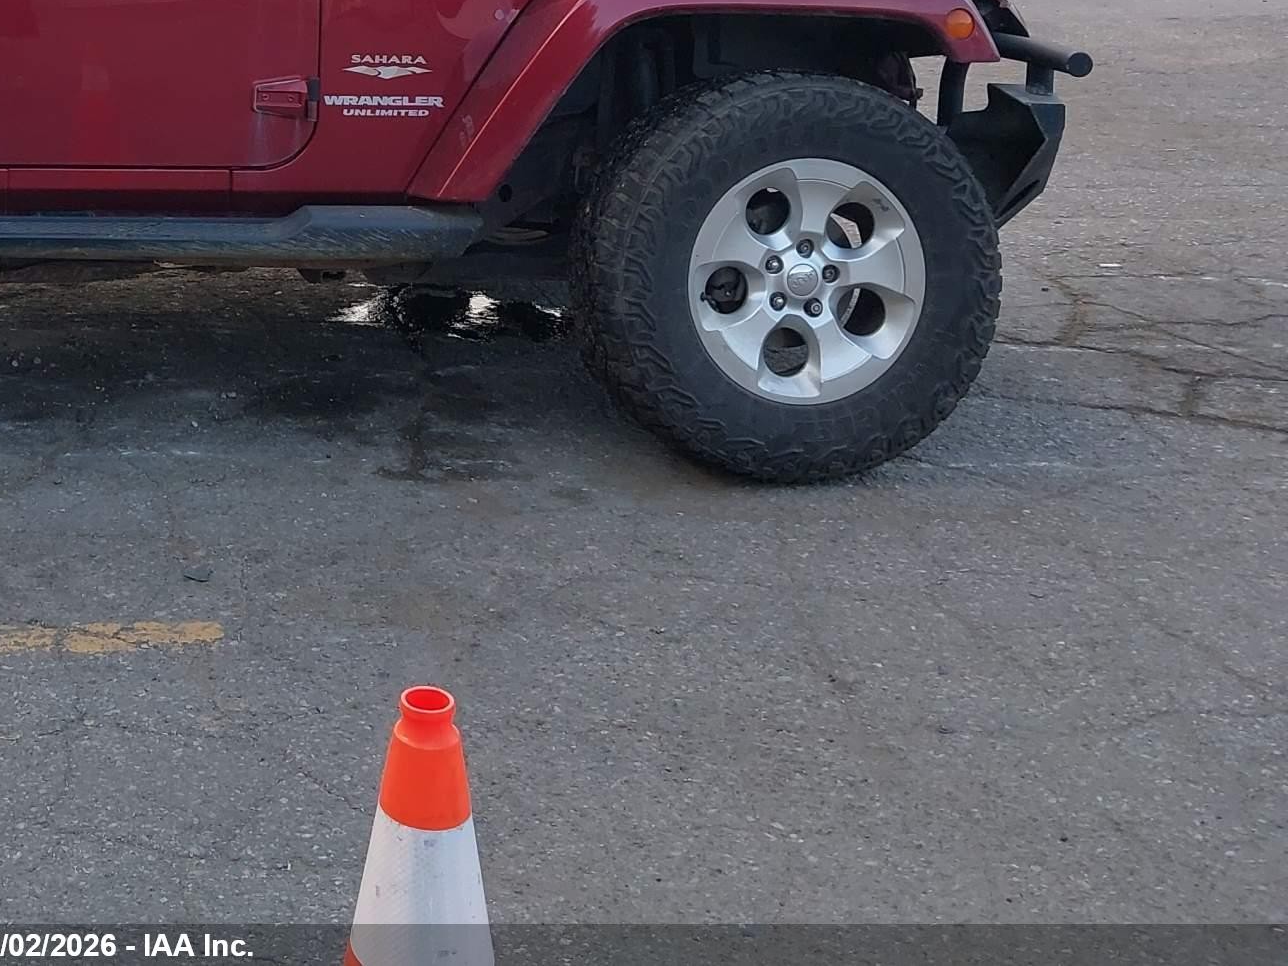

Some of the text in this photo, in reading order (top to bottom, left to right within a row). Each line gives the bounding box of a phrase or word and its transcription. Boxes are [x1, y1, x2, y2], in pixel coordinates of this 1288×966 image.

[351, 54, 427, 65] SAHARA
[323, 95, 445, 107] WRANGLER
[343, 109, 430, 117] UNLIMITED
